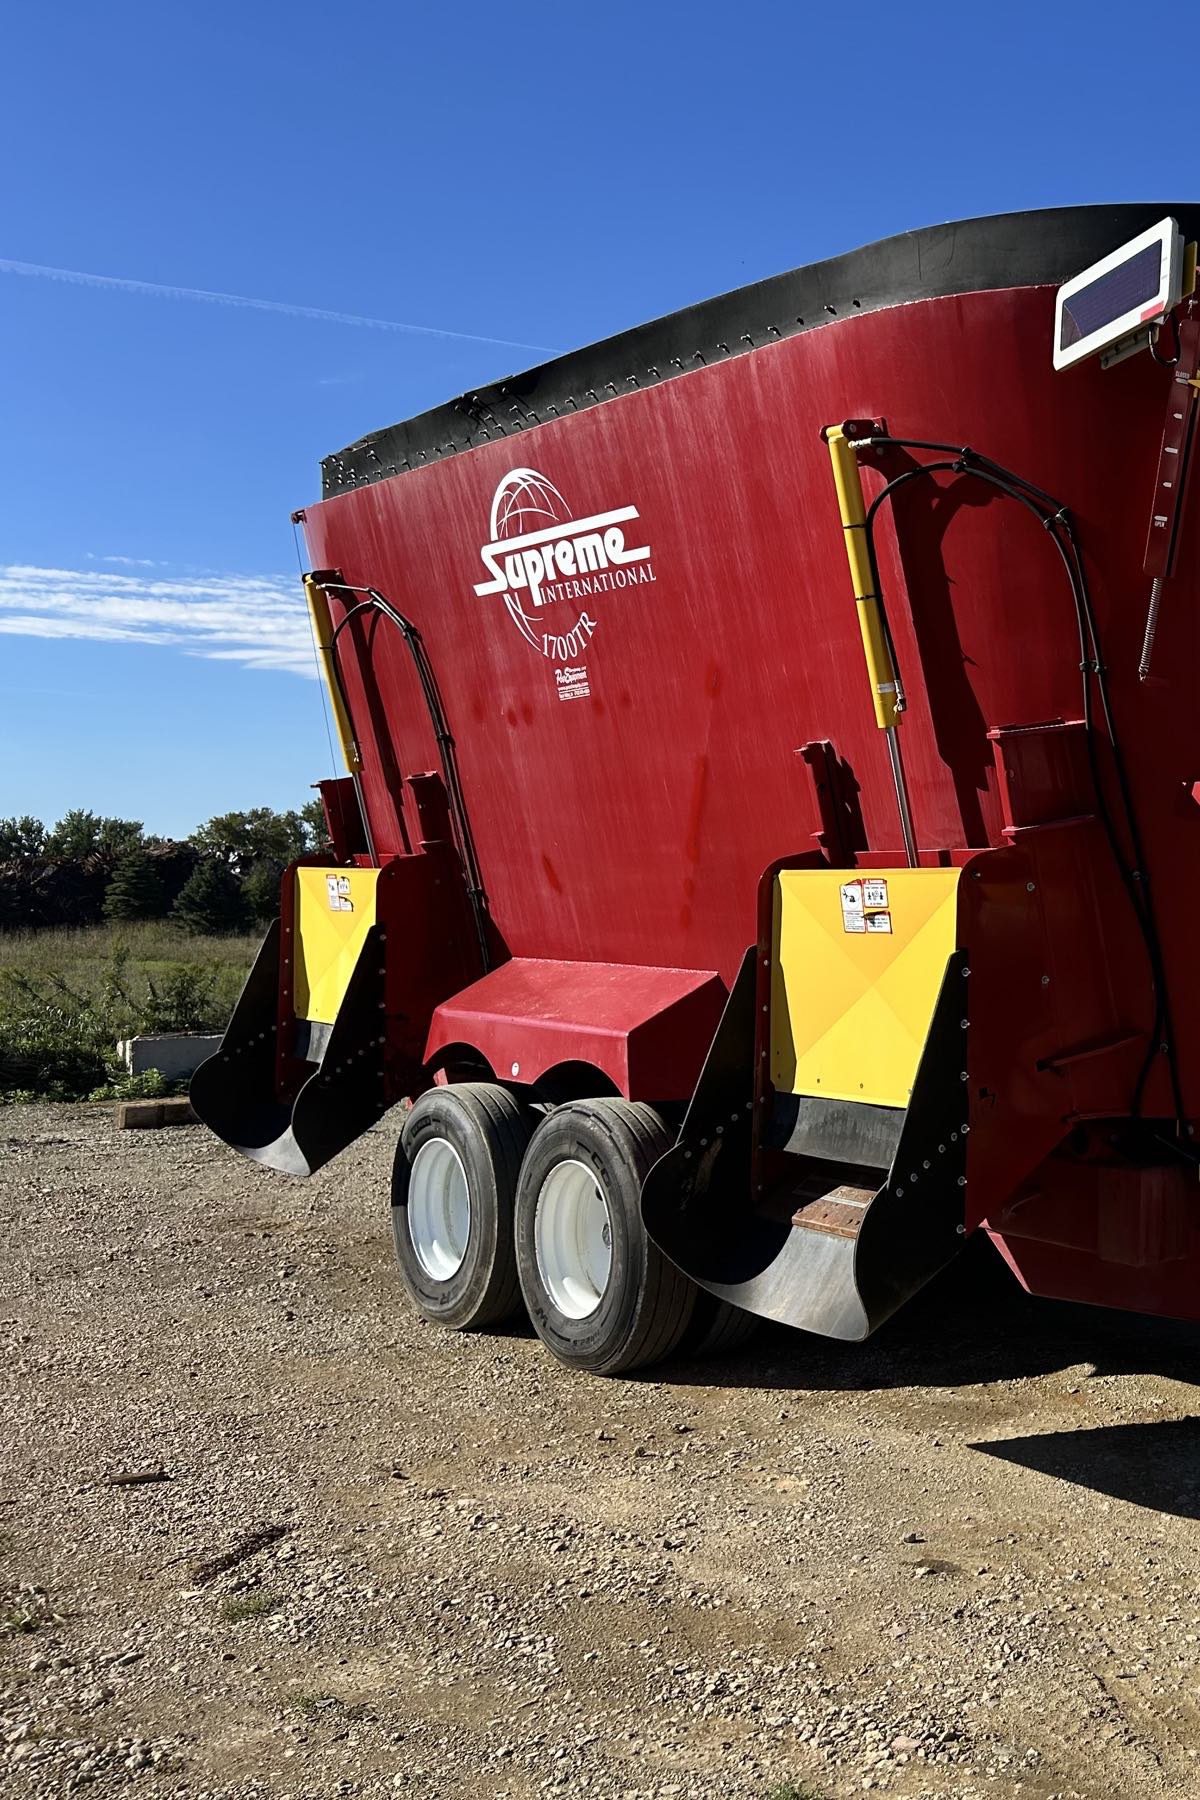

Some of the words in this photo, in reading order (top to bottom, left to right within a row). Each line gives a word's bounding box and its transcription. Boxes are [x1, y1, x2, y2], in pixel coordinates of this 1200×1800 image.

[473, 504, 651, 607] Supreme
[540, 563, 657, 605] INTERNATIONAL
[542, 611, 597, 661] 1700TR
